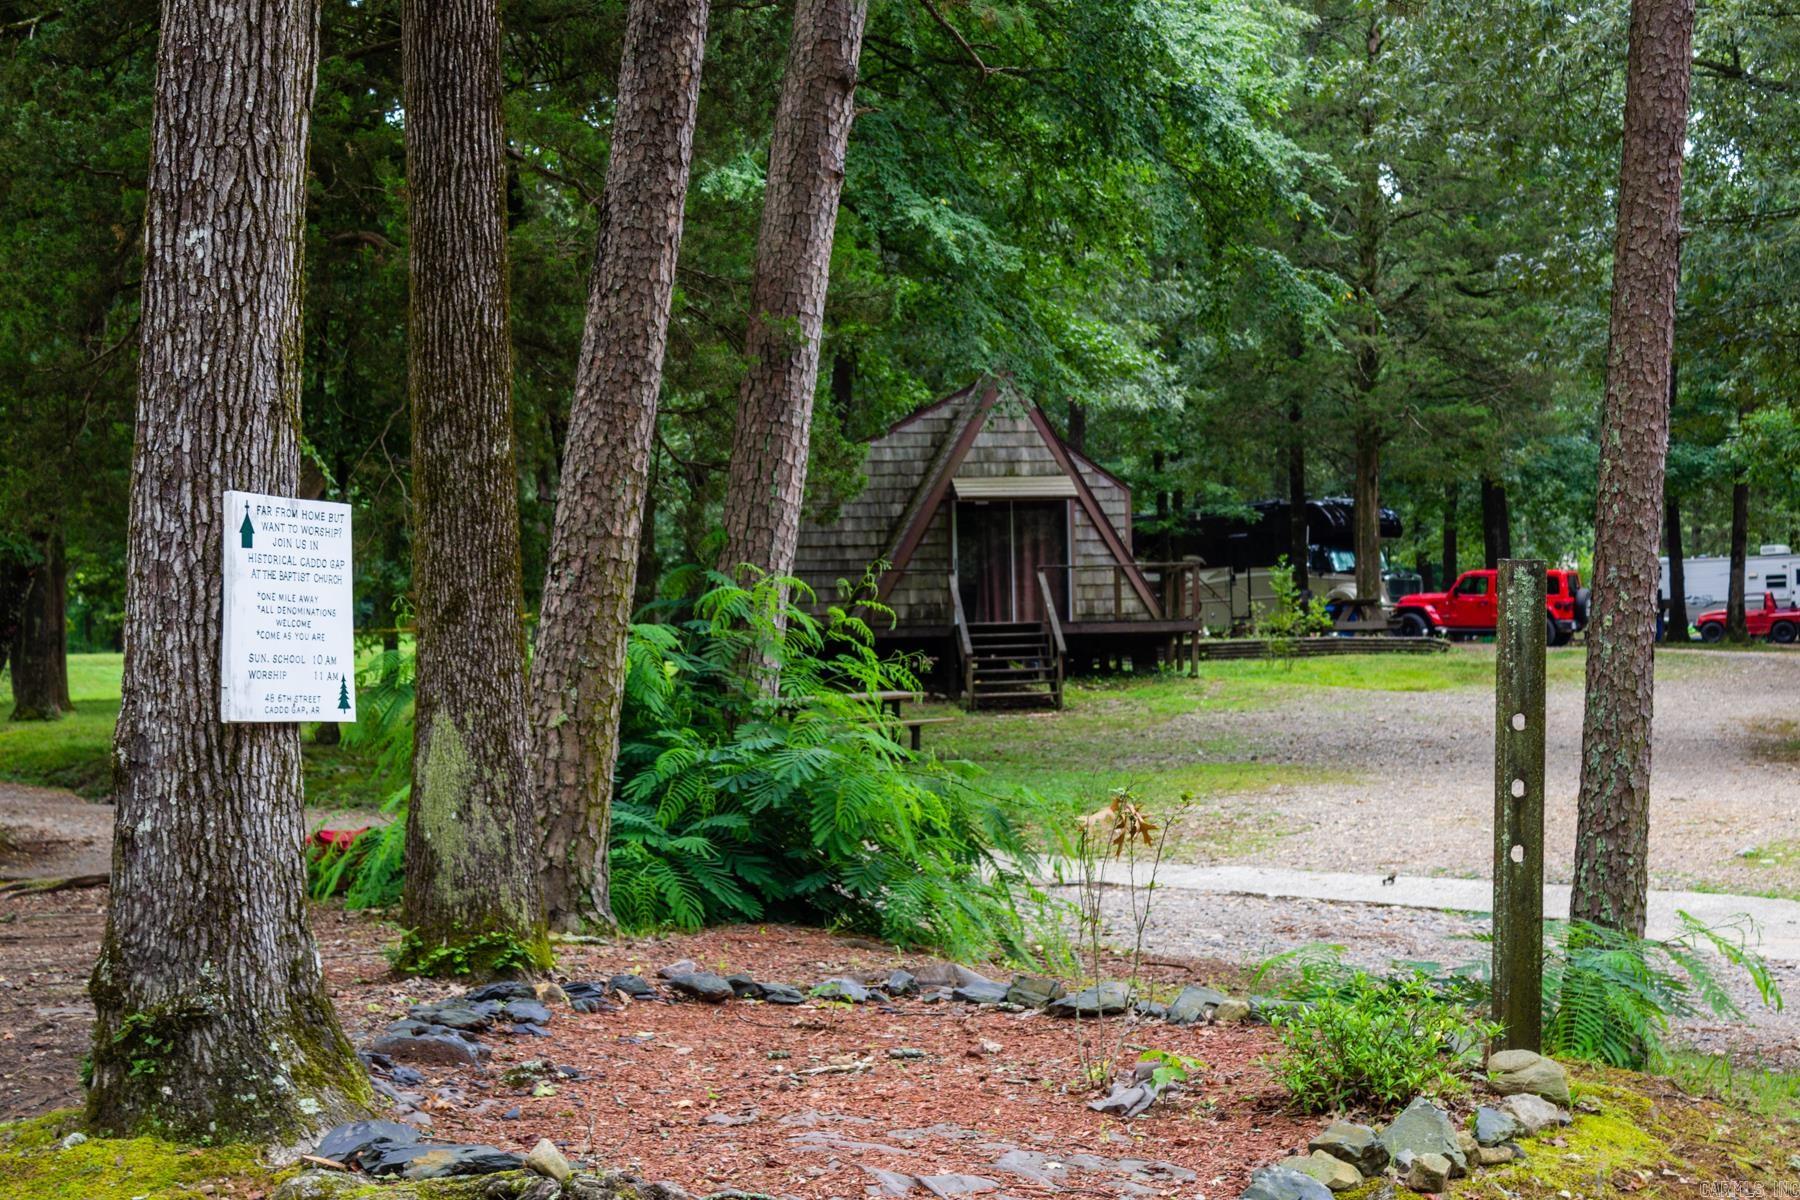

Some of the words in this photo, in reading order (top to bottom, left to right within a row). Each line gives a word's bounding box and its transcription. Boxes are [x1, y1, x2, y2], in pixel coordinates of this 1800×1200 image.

[256, 505, 272, 516] FAR
[276, 507, 298, 518] FROM
[302, 510, 325, 521] HOME
[329, 513, 344, 523] BUT
[262, 522, 285, 531] WANT
[288, 524, 297, 533] TO
[301, 525, 342, 538] WORSHIP?
[273, 538, 292, 548] JOIN
[296, 540, 306, 549] US
[310, 540, 319, 550] IN
[248, 553, 297, 566] HISTORICAL
[300, 557, 327, 568] CADDO
[330, 560, 345, 570] GAP
[251, 569, 261, 579] AT
[263, 570, 276, 579] THE
[279, 571, 310, 582] BAPTIST
[314, 573, 342, 584] CHURCH
[279, 594, 296, 602] MILE
[299, 595, 319, 603] AWAY
[277, 606, 336, 617] DENOMINATIONS
[276, 619, 311, 628] WELCOME
[283, 632, 291, 640] AS
[312, 633, 325, 641] ARE
[248, 653, 269, 663] SUN.
[272, 654, 306, 664] SCHOOL
[313, 655, 323, 664] 10
[325, 656, 336, 665] AM
[248, 670, 287, 680] WORSHIP
[314, 671, 323, 680] 11
[327, 672, 338, 681] AM
[277, 694, 292, 702] 6TH
[294, 695, 322, 703] STREET
